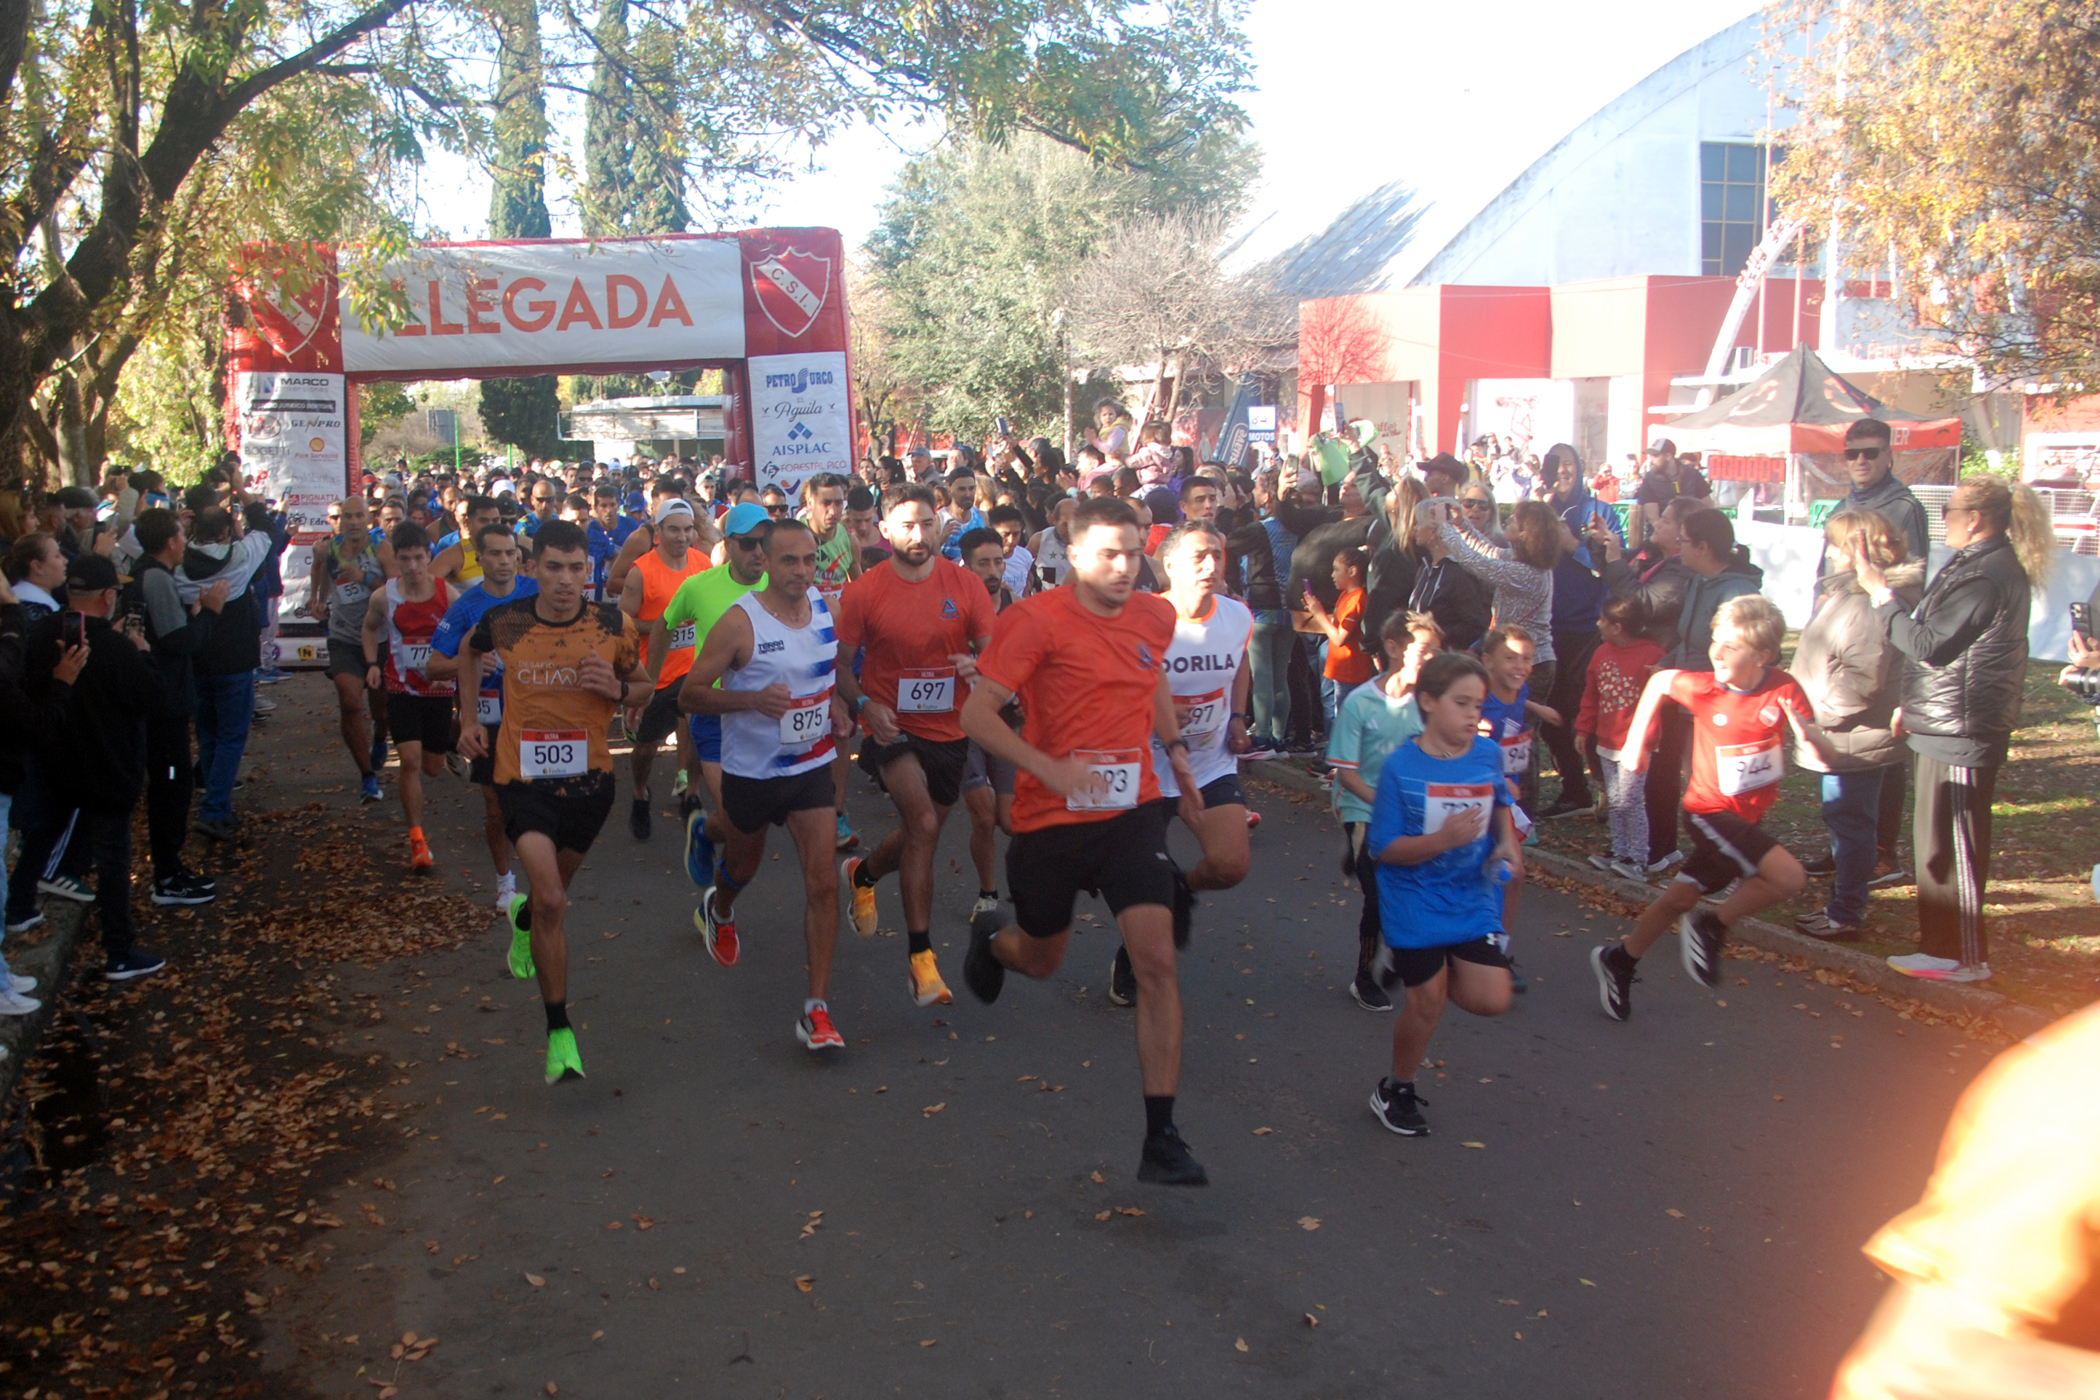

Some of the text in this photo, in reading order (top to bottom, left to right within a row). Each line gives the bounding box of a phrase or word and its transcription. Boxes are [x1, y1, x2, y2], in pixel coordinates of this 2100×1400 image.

[771, 268, 809, 308] C.S.I.
[281, 378, 329, 386] MARCO
[291, 416, 341, 432] GENPRO
[1248, 432, 1276, 441] MOTOS
[772, 442, 831, 456] AISPLAC
[1228, 429, 1248, 466] suave
[781, 460, 847, 473] FORESTAL PICO
[911, 682, 945, 700] 697
[793, 707, 823, 732] 875
[1187, 705, 1215, 726] 97
[534, 744, 573, 764] 503
